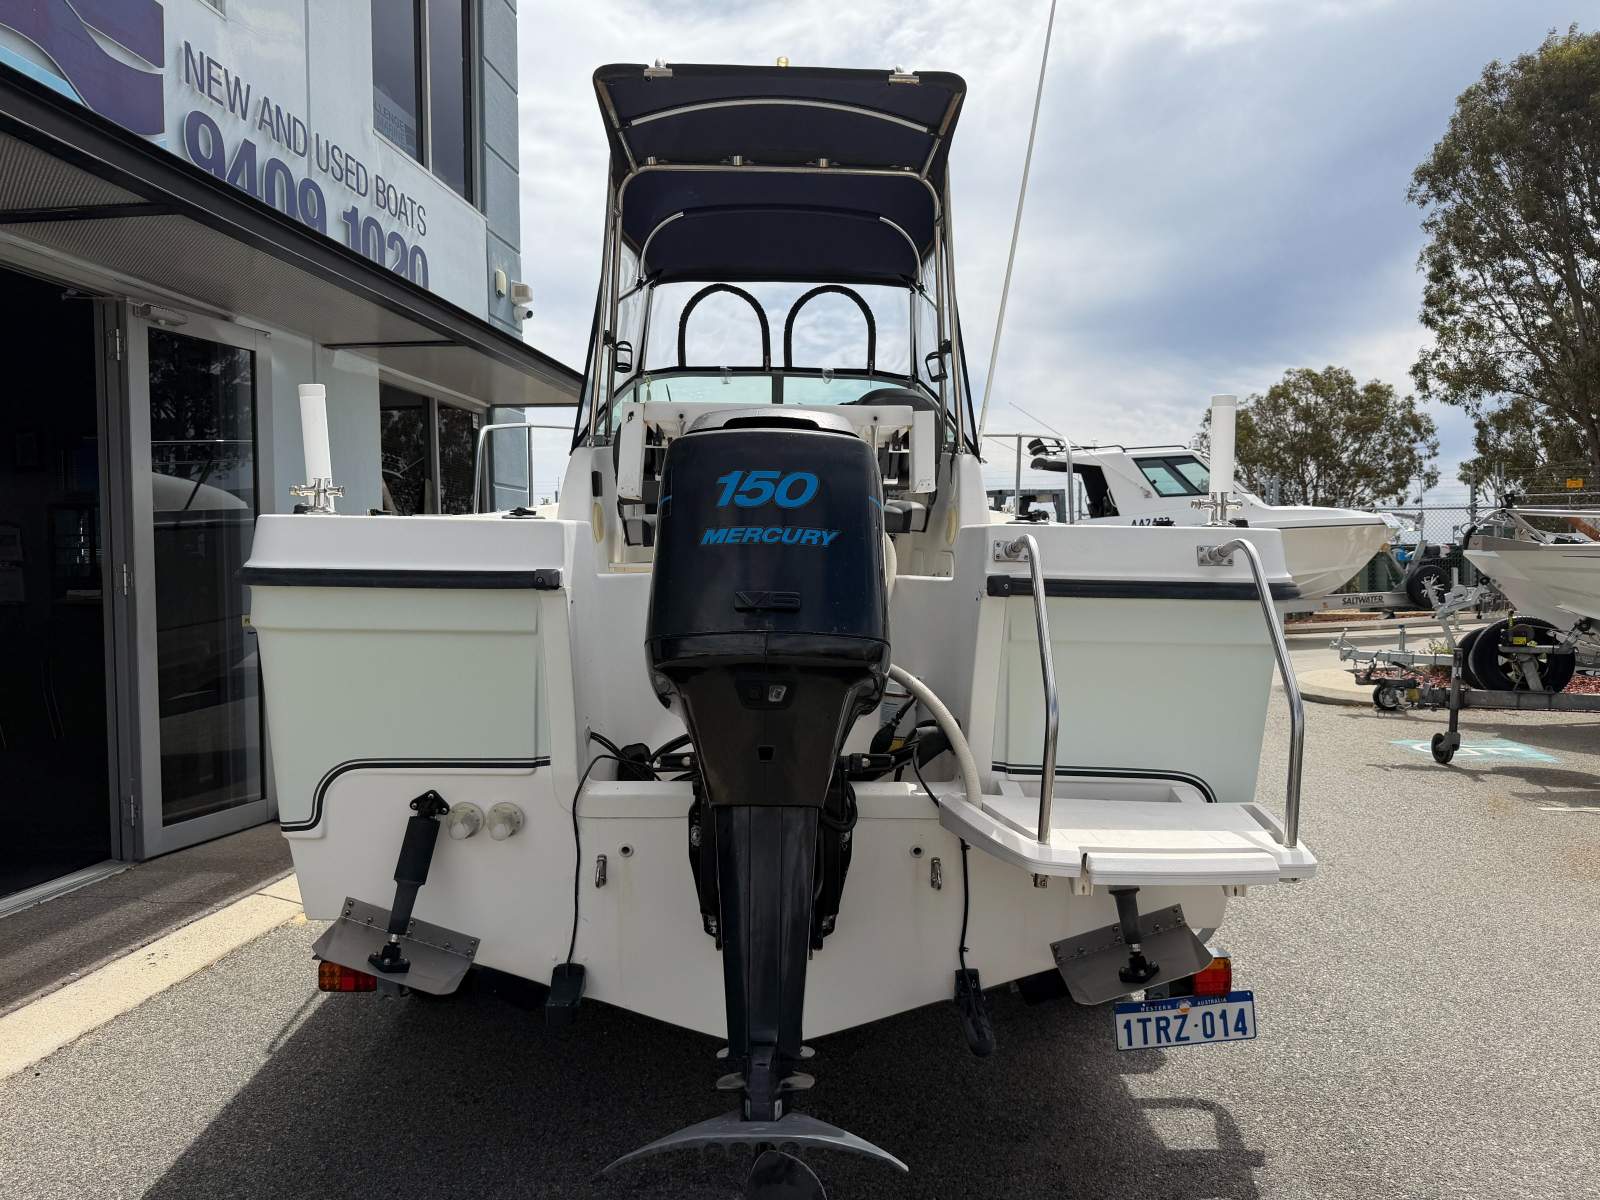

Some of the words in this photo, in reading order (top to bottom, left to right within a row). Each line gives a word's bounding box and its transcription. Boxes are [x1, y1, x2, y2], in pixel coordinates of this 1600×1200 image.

[184, 40, 250, 121] NEW
[258, 96, 307, 157] AND
[315, 132, 368, 198] USED
[375, 174, 427, 236] BOATS
[184, 111, 327, 236] 9409
[716, 470, 820, 509] 150
[701, 527, 840, 546] MERCURY
[1342, 595, 1384, 606] SALTWATER
[1140, 1004, 1172, 1012] WESTERN
[1197, 997, 1227, 1006] AUSTRALIA
